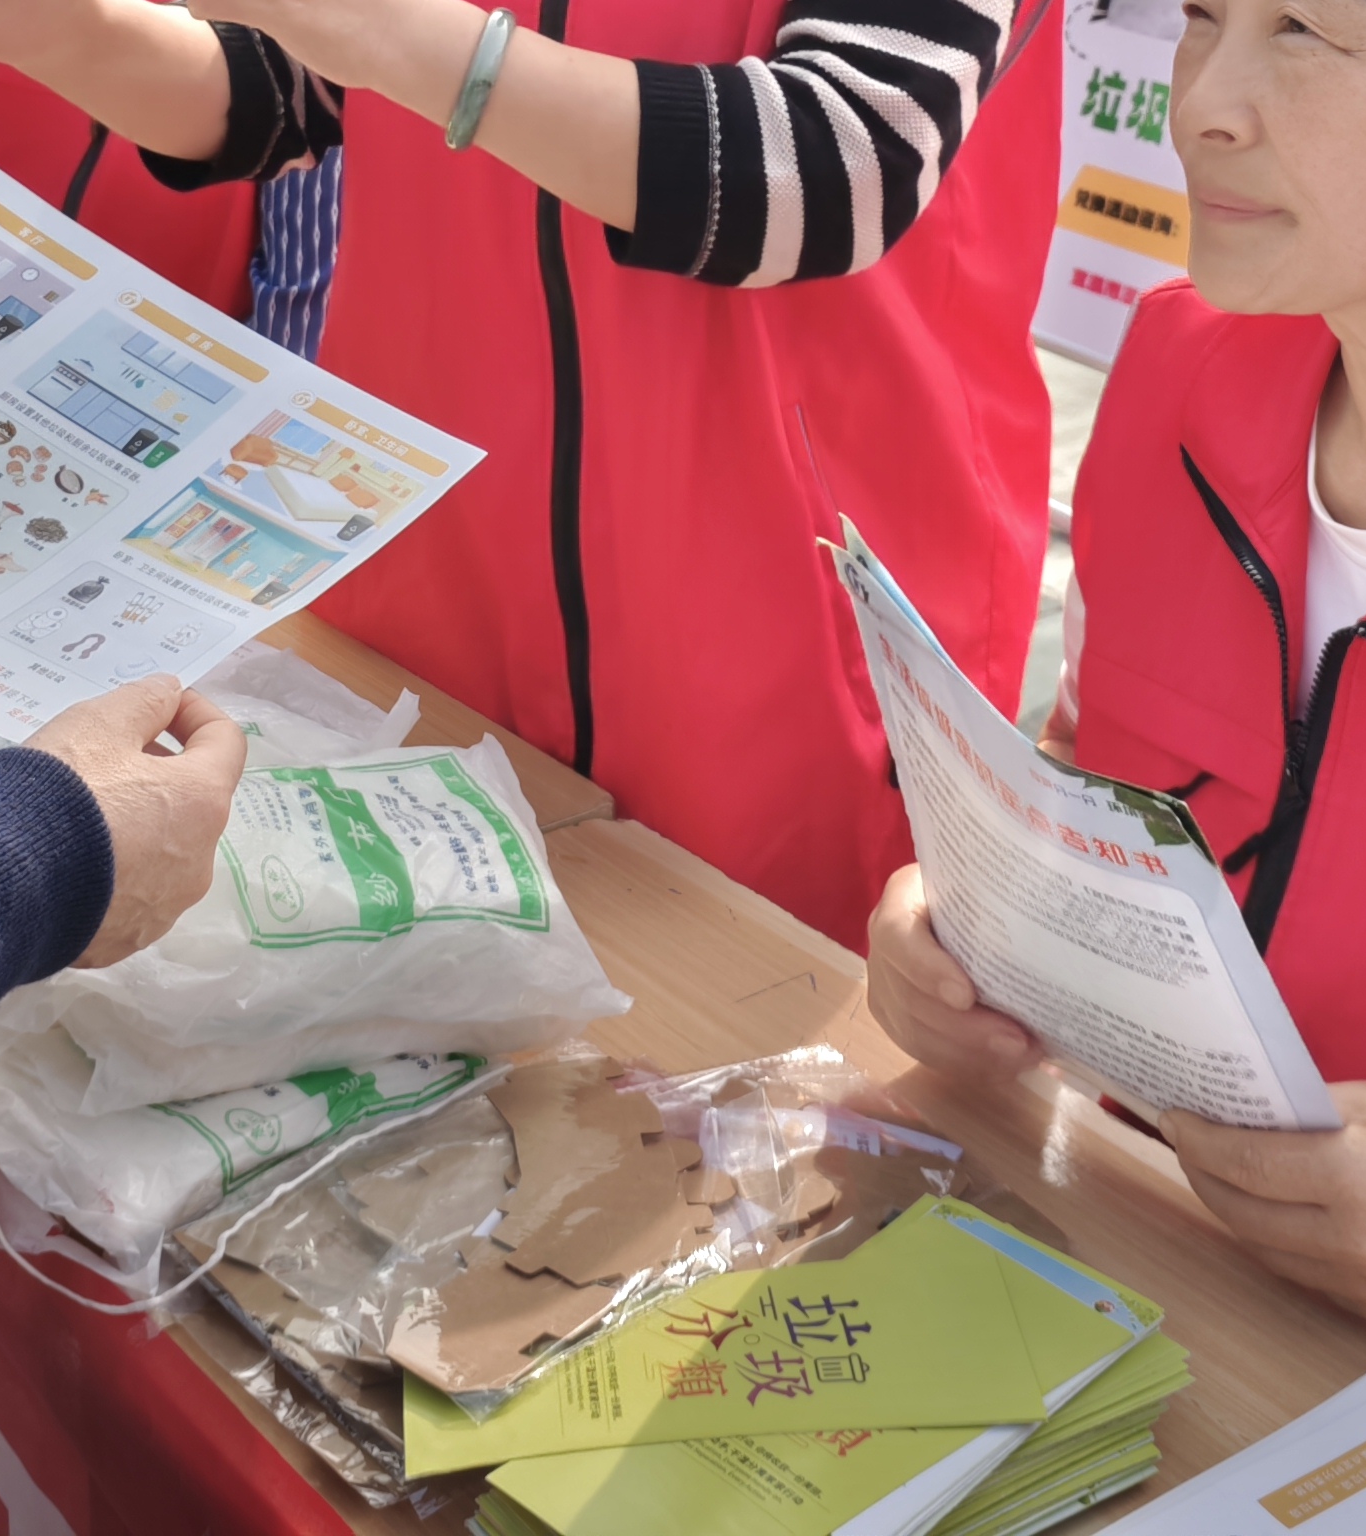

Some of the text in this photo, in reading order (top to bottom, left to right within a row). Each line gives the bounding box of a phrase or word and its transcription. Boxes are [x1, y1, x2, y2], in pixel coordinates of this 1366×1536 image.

[1080, 66, 1170, 147] 垃圾
[18, 225, 46, 248] 客厅
[185, 331, 214, 352] 厨房
[343, 419, 410, 458] 卧室、卫生间
